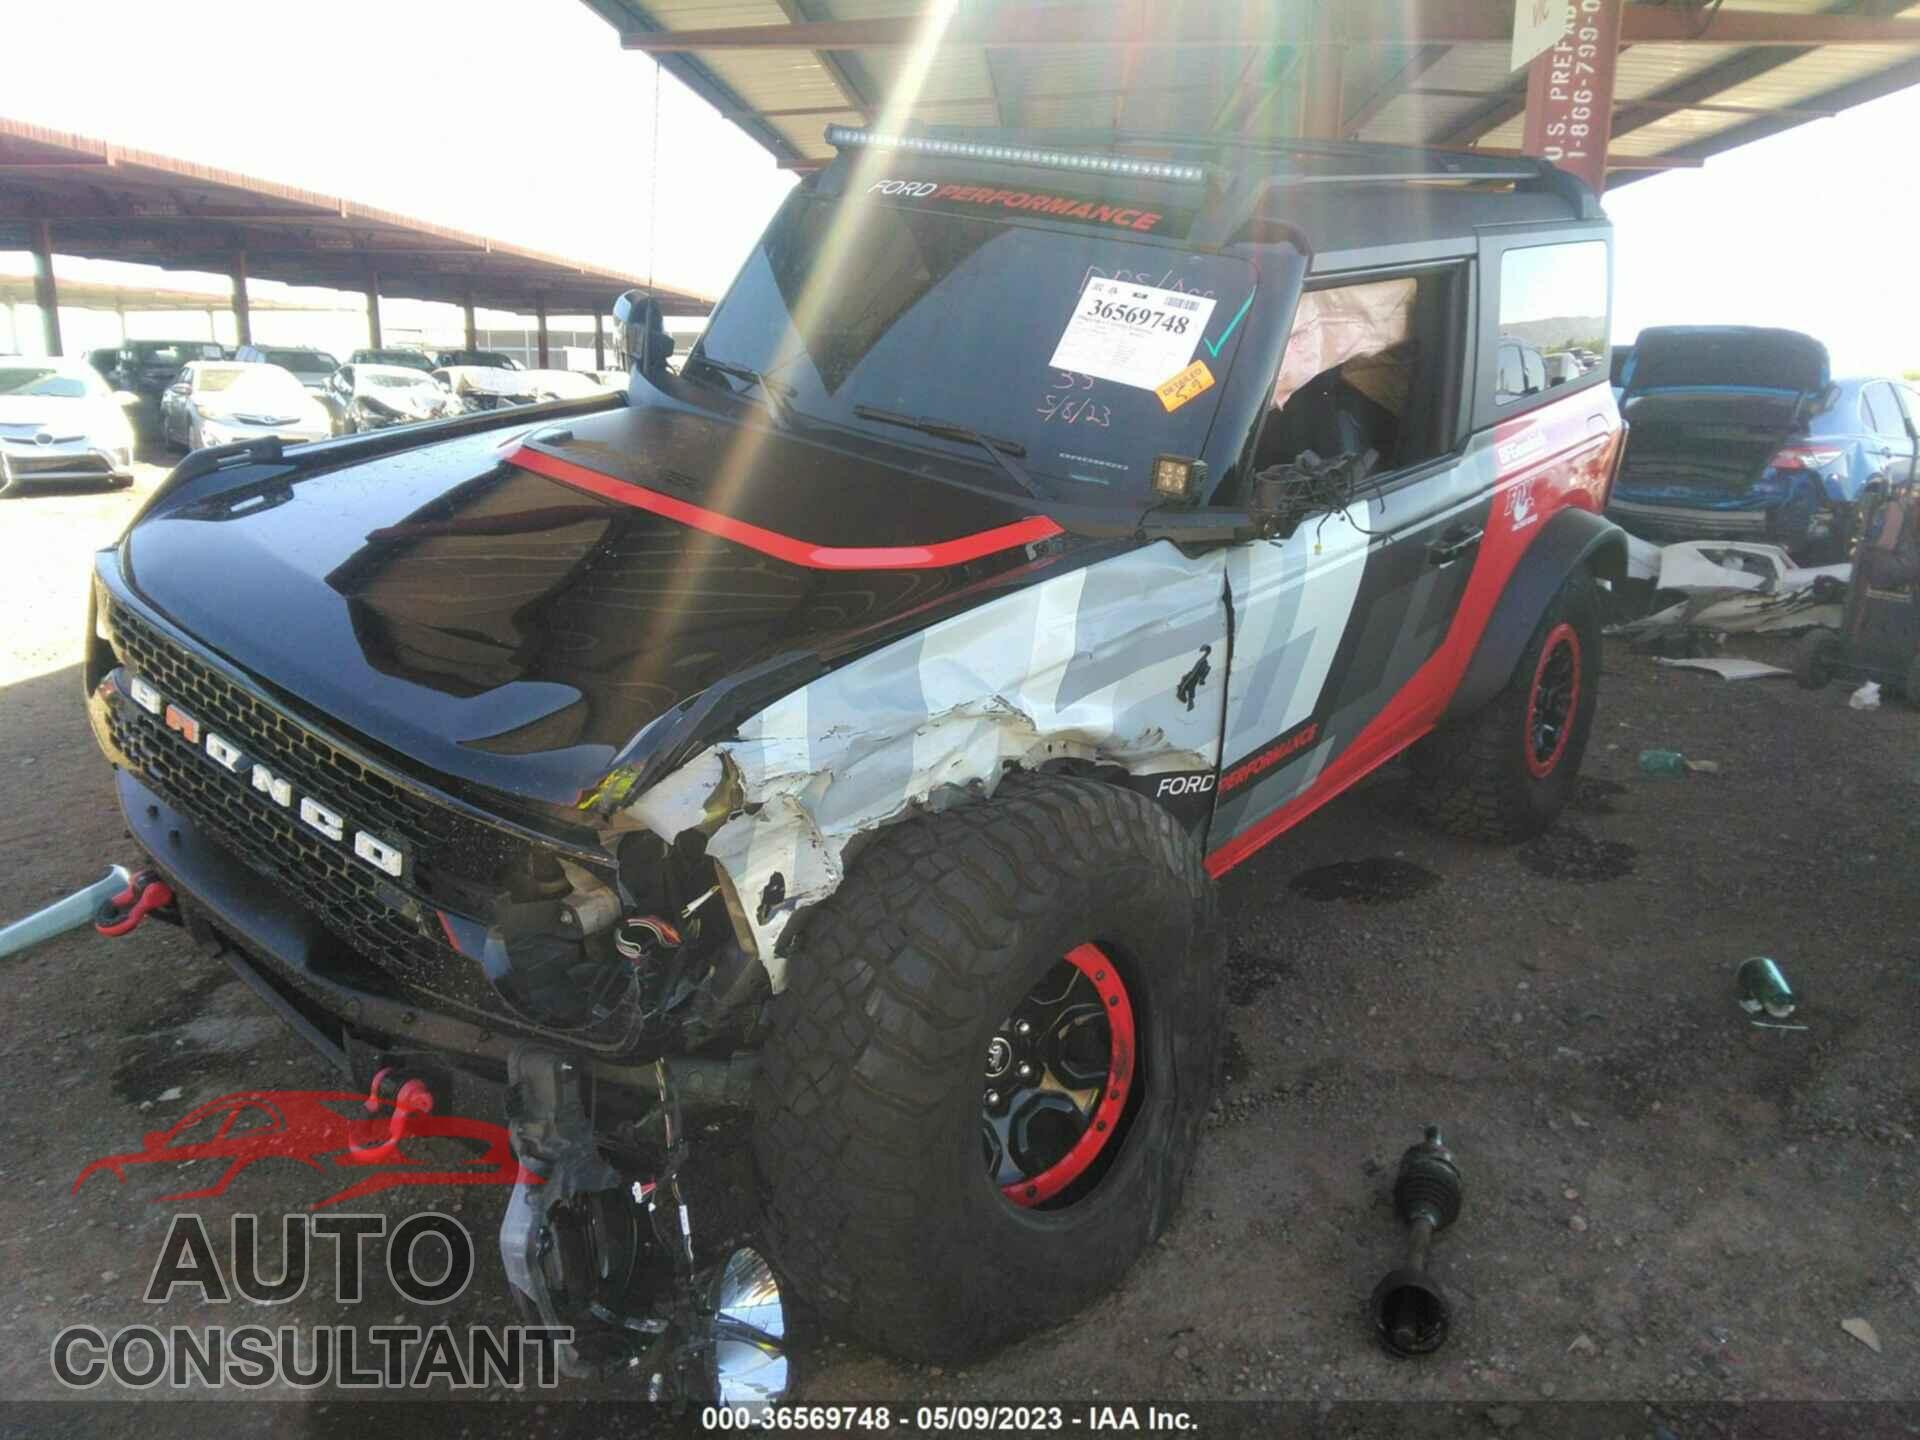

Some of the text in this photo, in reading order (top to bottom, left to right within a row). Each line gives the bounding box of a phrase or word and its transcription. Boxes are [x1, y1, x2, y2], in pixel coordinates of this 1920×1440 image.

[867, 180, 1163, 231] FORD PERFORMANCE
[1087, 298, 1190, 335] 36569748
[130, 677, 403, 877] BRONCO
[1156, 774, 1215, 798] FORD
